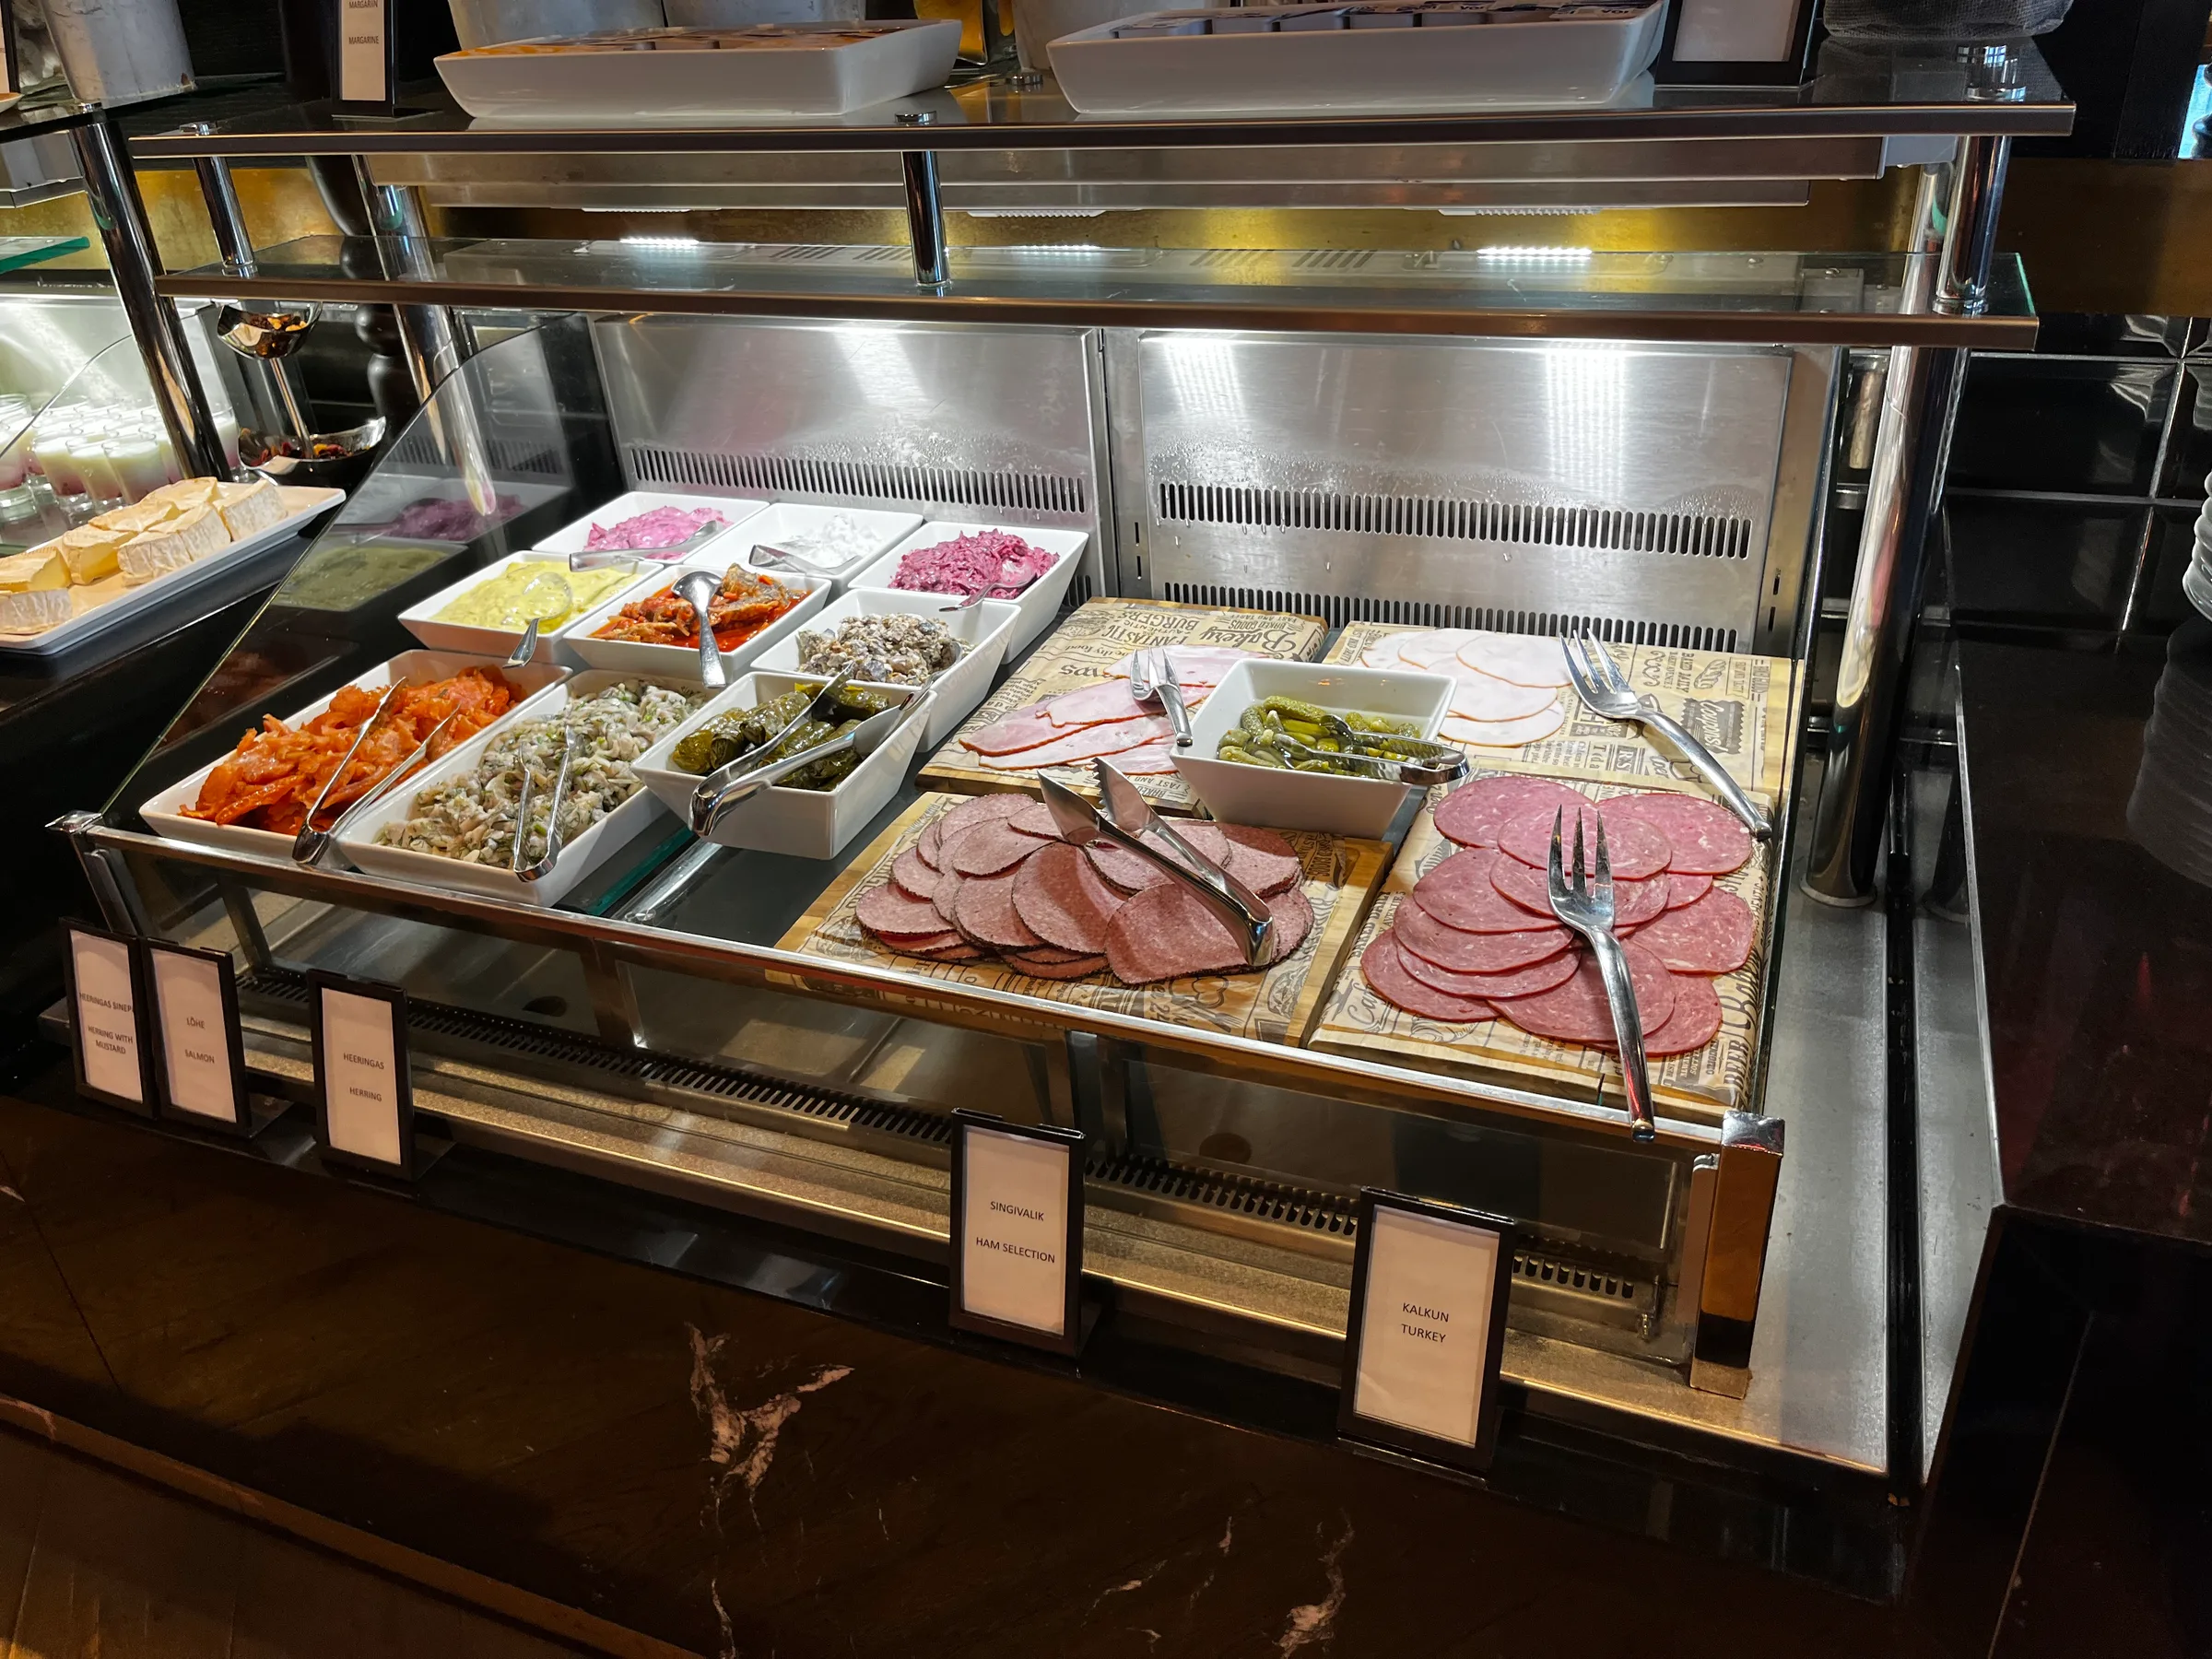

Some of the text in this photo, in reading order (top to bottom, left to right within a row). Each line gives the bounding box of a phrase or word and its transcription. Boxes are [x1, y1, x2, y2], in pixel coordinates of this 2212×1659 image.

[348, 35, 379, 45] MARGARINE
[1121, 610, 1200, 632] BURGERS
[1258, 620, 1286, 630] BAKED
[1199, 629, 1297, 653] Bakery
[1696, 701, 1729, 752] Coupons!
[1157, 779, 1181, 790] FAST
[1347, 922, 1376, 959] BAKED
[1371, 891, 1391, 920] DAILY
[79, 992, 134, 1013] HEERINGAS SINEP
[88, 1025, 134, 1044] HERRING WITH
[95, 1040, 126, 1054] MUSTARD
[184, 1049, 215, 1064] SALMON
[343, 1052, 385, 1070] HEERINGAS
[1723, 1040, 1750, 1089] BEER
[349, 1087, 382, 1102] HERRING
[990, 1201, 1044, 1221] SINGIVALIK
[976, 1237, 1055, 1264] HAM SELECTION
[1402, 1302, 1449, 1323] KALKUN
[1401, 1324, 1446, 1343] TURKEY
